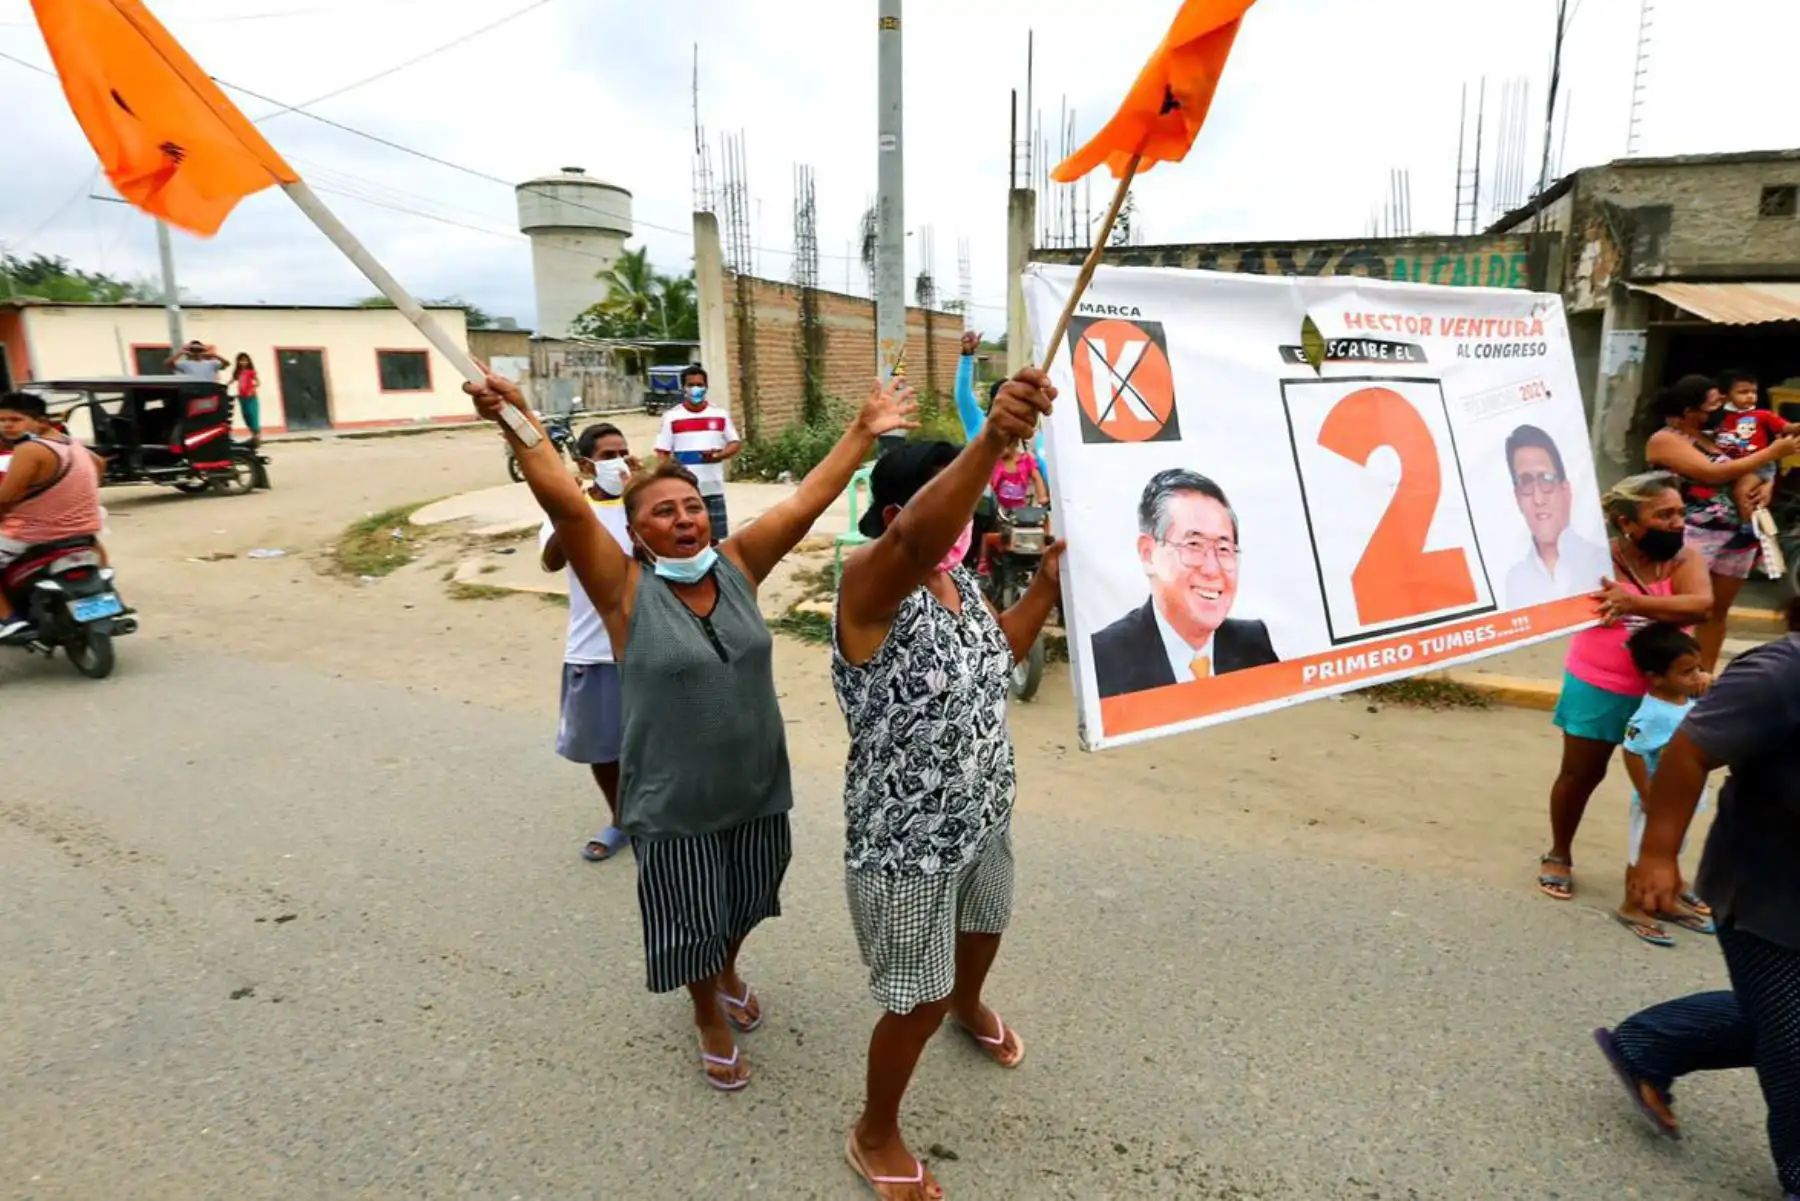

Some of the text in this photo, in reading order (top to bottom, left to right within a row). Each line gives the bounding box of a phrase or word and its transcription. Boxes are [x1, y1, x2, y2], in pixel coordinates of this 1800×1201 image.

[1392, 253, 1527, 289] ALCALDE
[1079, 303, 1141, 317] MARCA
[1343, 311, 1545, 338] HECTOR VENTURA
[1395, 345, 1416, 360] EL
[1457, 342, 1547, 359] AL CONGRESO
[1317, 387, 1480, 626] 2
[1302, 644, 1414, 684] PRIMERO
